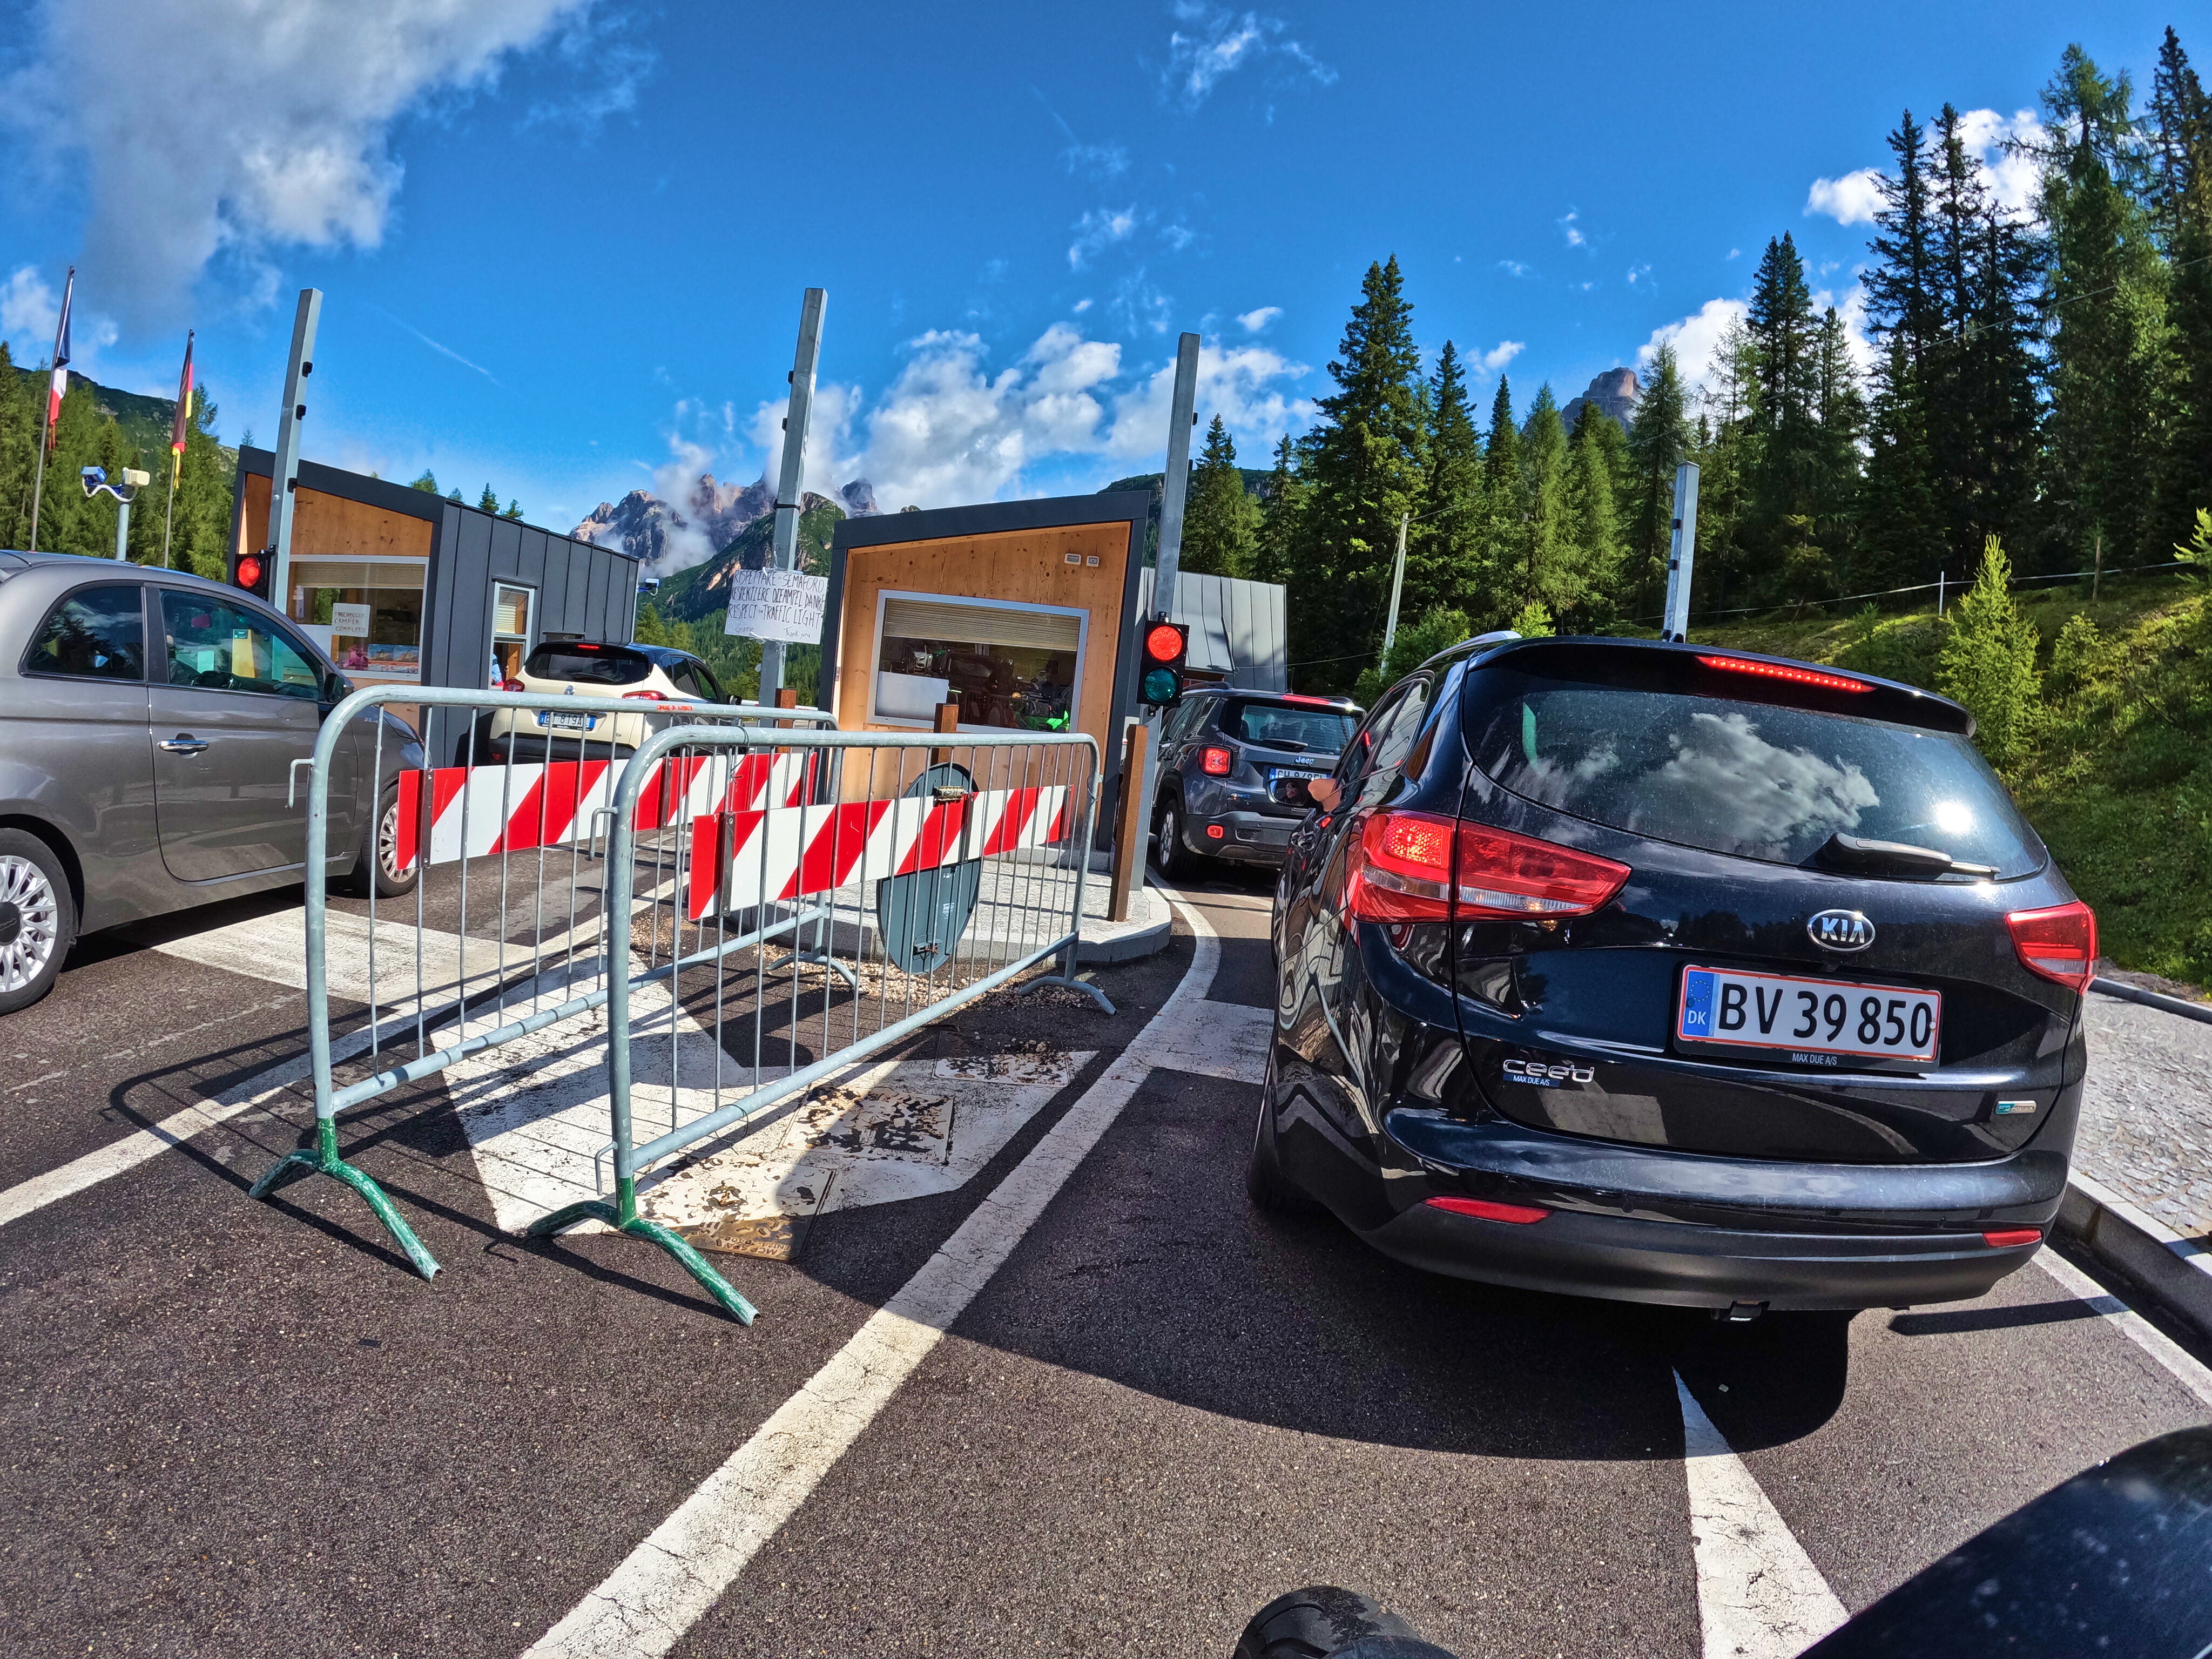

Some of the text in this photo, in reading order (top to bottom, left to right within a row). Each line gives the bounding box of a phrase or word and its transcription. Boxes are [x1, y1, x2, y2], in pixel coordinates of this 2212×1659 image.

[734, 570, 777, 586] RISPETTARE
[782, 574, 825, 593] SEMAFORO
[804, 592, 826, 612] DANKE
[727, 603, 758, 619] RESPECT
[763, 604, 792, 624] TRAFFIC
[793, 609, 822, 630] LIGHT
[783, 626, 799, 638] Thank
[1296, 756, 1314, 766] Jeep
[1820, 917, 1865, 943] KIA
[1688, 1010, 1707, 1026] DK
[1718, 983, 1933, 1048] BV 39 850
[1792, 1053, 1837, 1066] MAX DUE A/S
[1513, 1075, 1527, 1083] MAX
[1527, 1077, 1540, 1085] DUE
